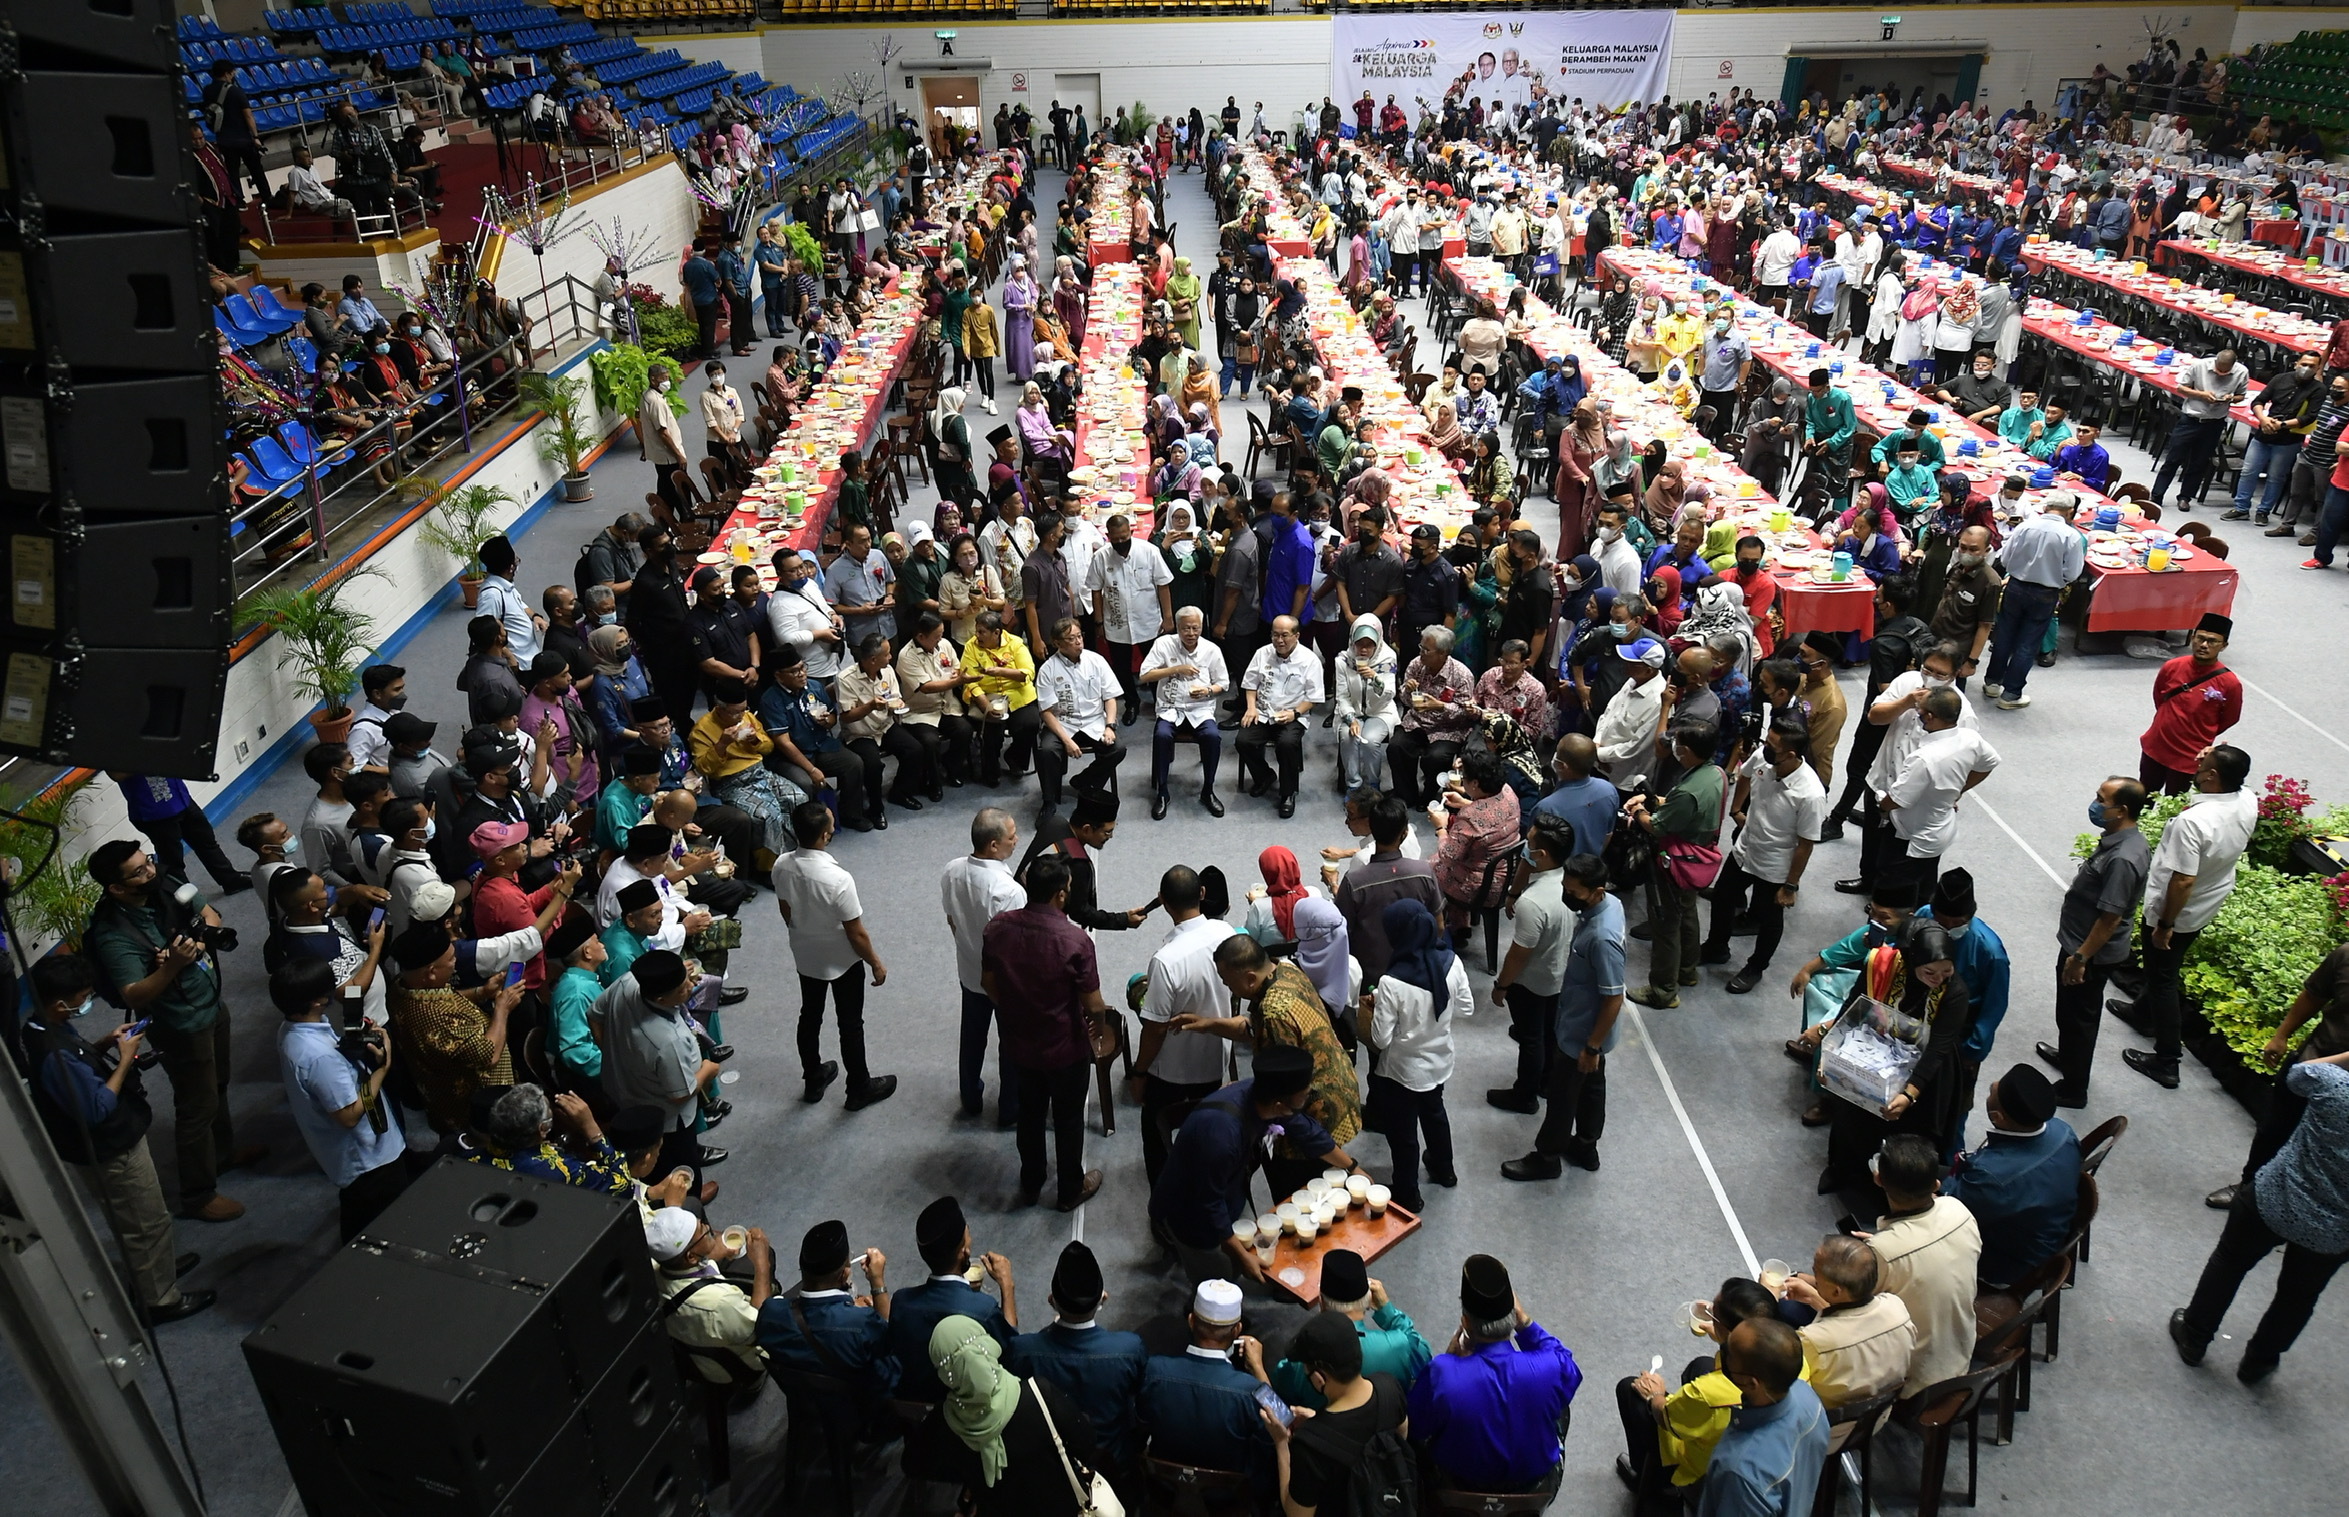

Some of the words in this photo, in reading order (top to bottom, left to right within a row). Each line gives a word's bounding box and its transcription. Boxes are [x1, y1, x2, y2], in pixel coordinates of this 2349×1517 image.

[942, 42, 954, 55] A
[1562, 45, 1610, 54] KELUARGA
[1613, 44, 1658, 53] MALAYSIA
[1353, 52, 1437, 65] #KELUARGA
[1562, 55, 1611, 63] BERAMBEH
[1613, 55, 1646, 63] MAKAN
[1362, 66, 1433, 78] MALAYSIA
